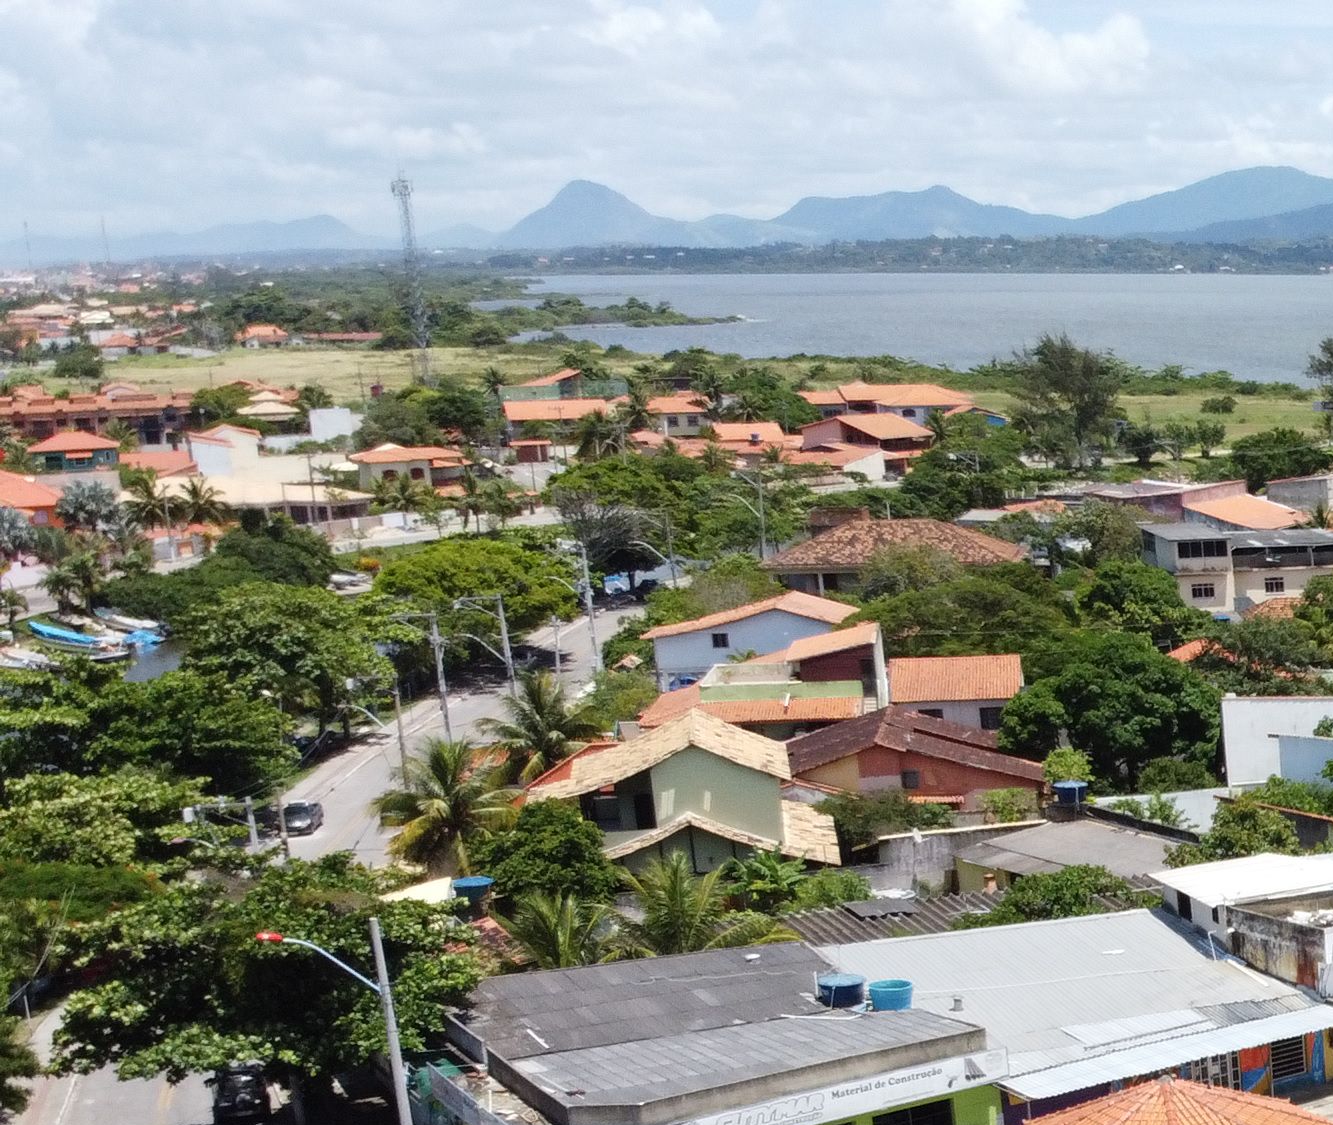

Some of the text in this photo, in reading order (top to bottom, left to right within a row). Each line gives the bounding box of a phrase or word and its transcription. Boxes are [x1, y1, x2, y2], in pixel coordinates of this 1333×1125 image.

[831, 1082, 873, 1100] Material
[874, 1079, 887, 1090] de
[888, 1067, 943, 1086] Construção
